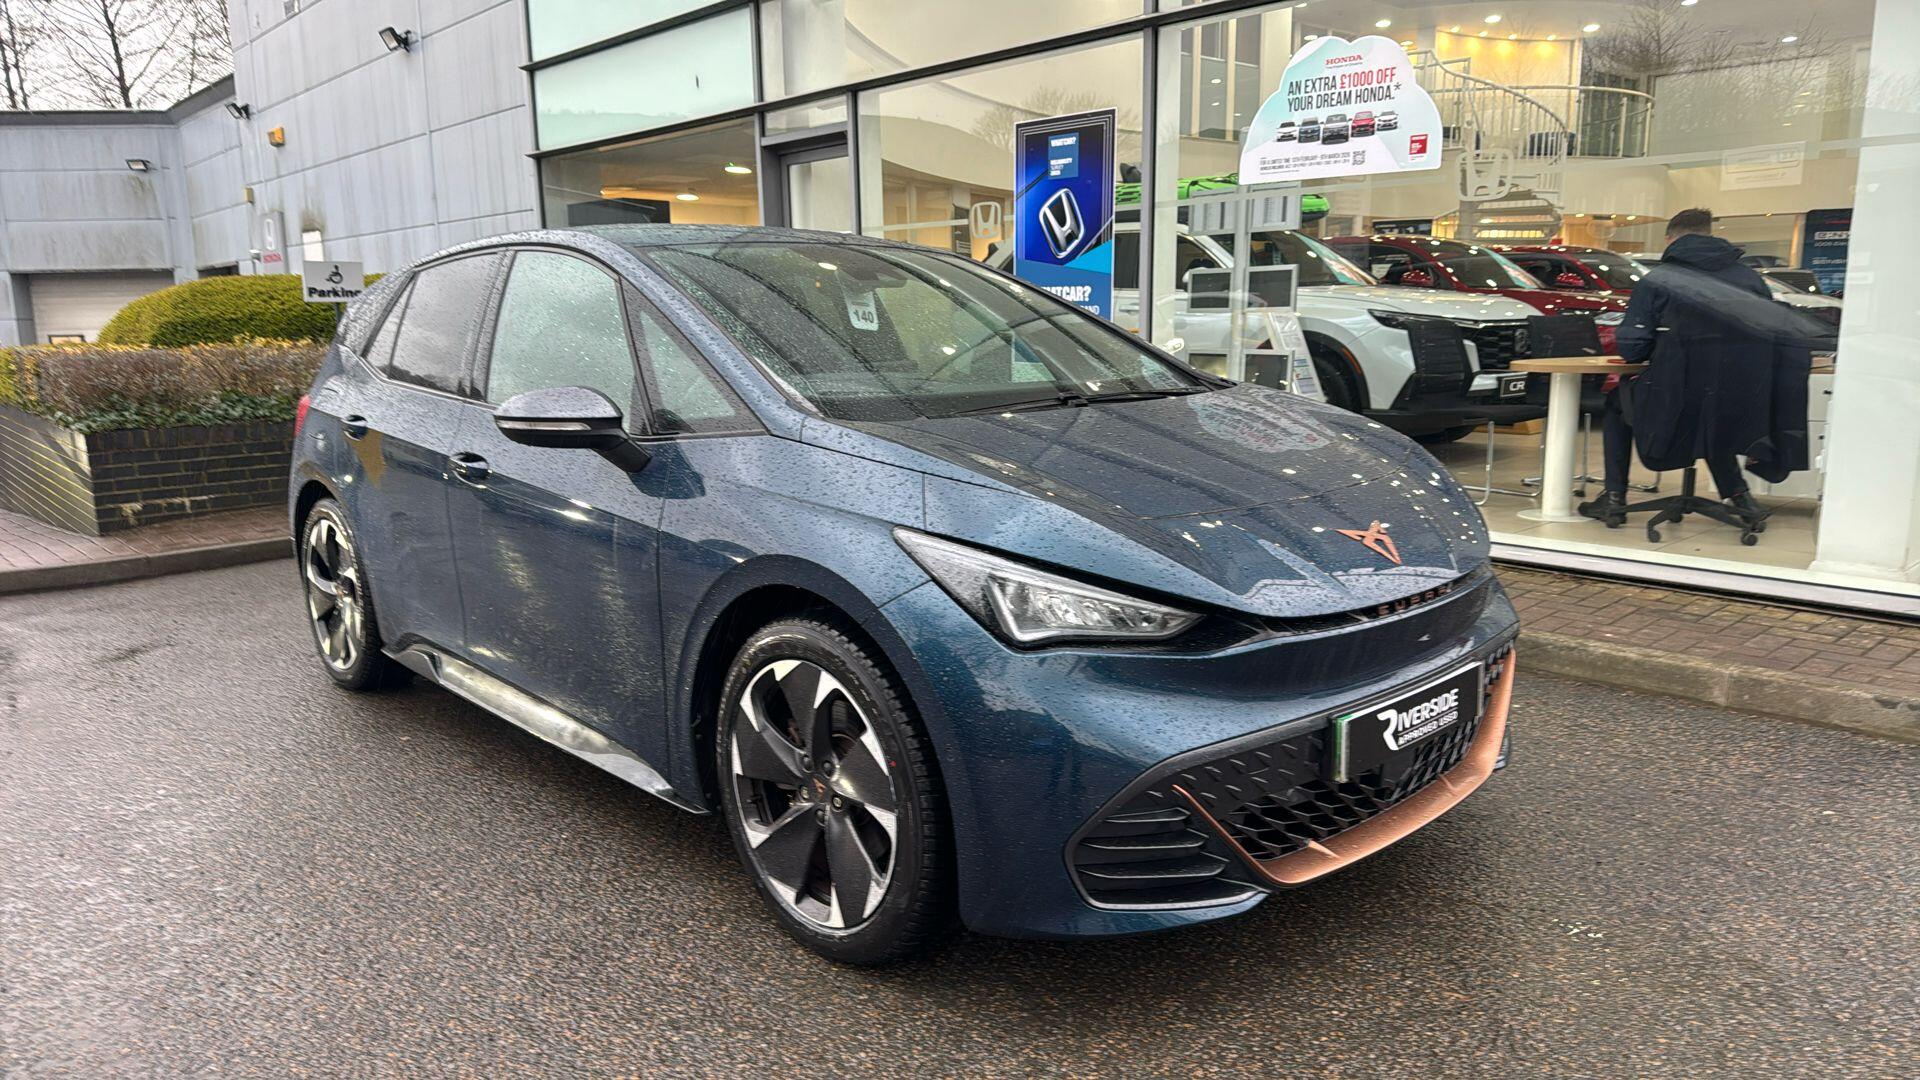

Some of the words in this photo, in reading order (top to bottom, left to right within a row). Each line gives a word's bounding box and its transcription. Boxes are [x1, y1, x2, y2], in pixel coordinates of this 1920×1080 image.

[1325, 54, 1363, 65] HONDA
[1288, 80, 1302, 96] AN
[1304, 75, 1337, 94] EXTRA
[1340, 70, 1374, 89] £1000
[1377, 66, 1397, 83] OFF
[1288, 94, 1313, 112] YOUR
[1316, 90, 1352, 109] DREAM
[853, 309, 874, 323] 140
[1376, 688, 1459, 750] RIVERSIDE
